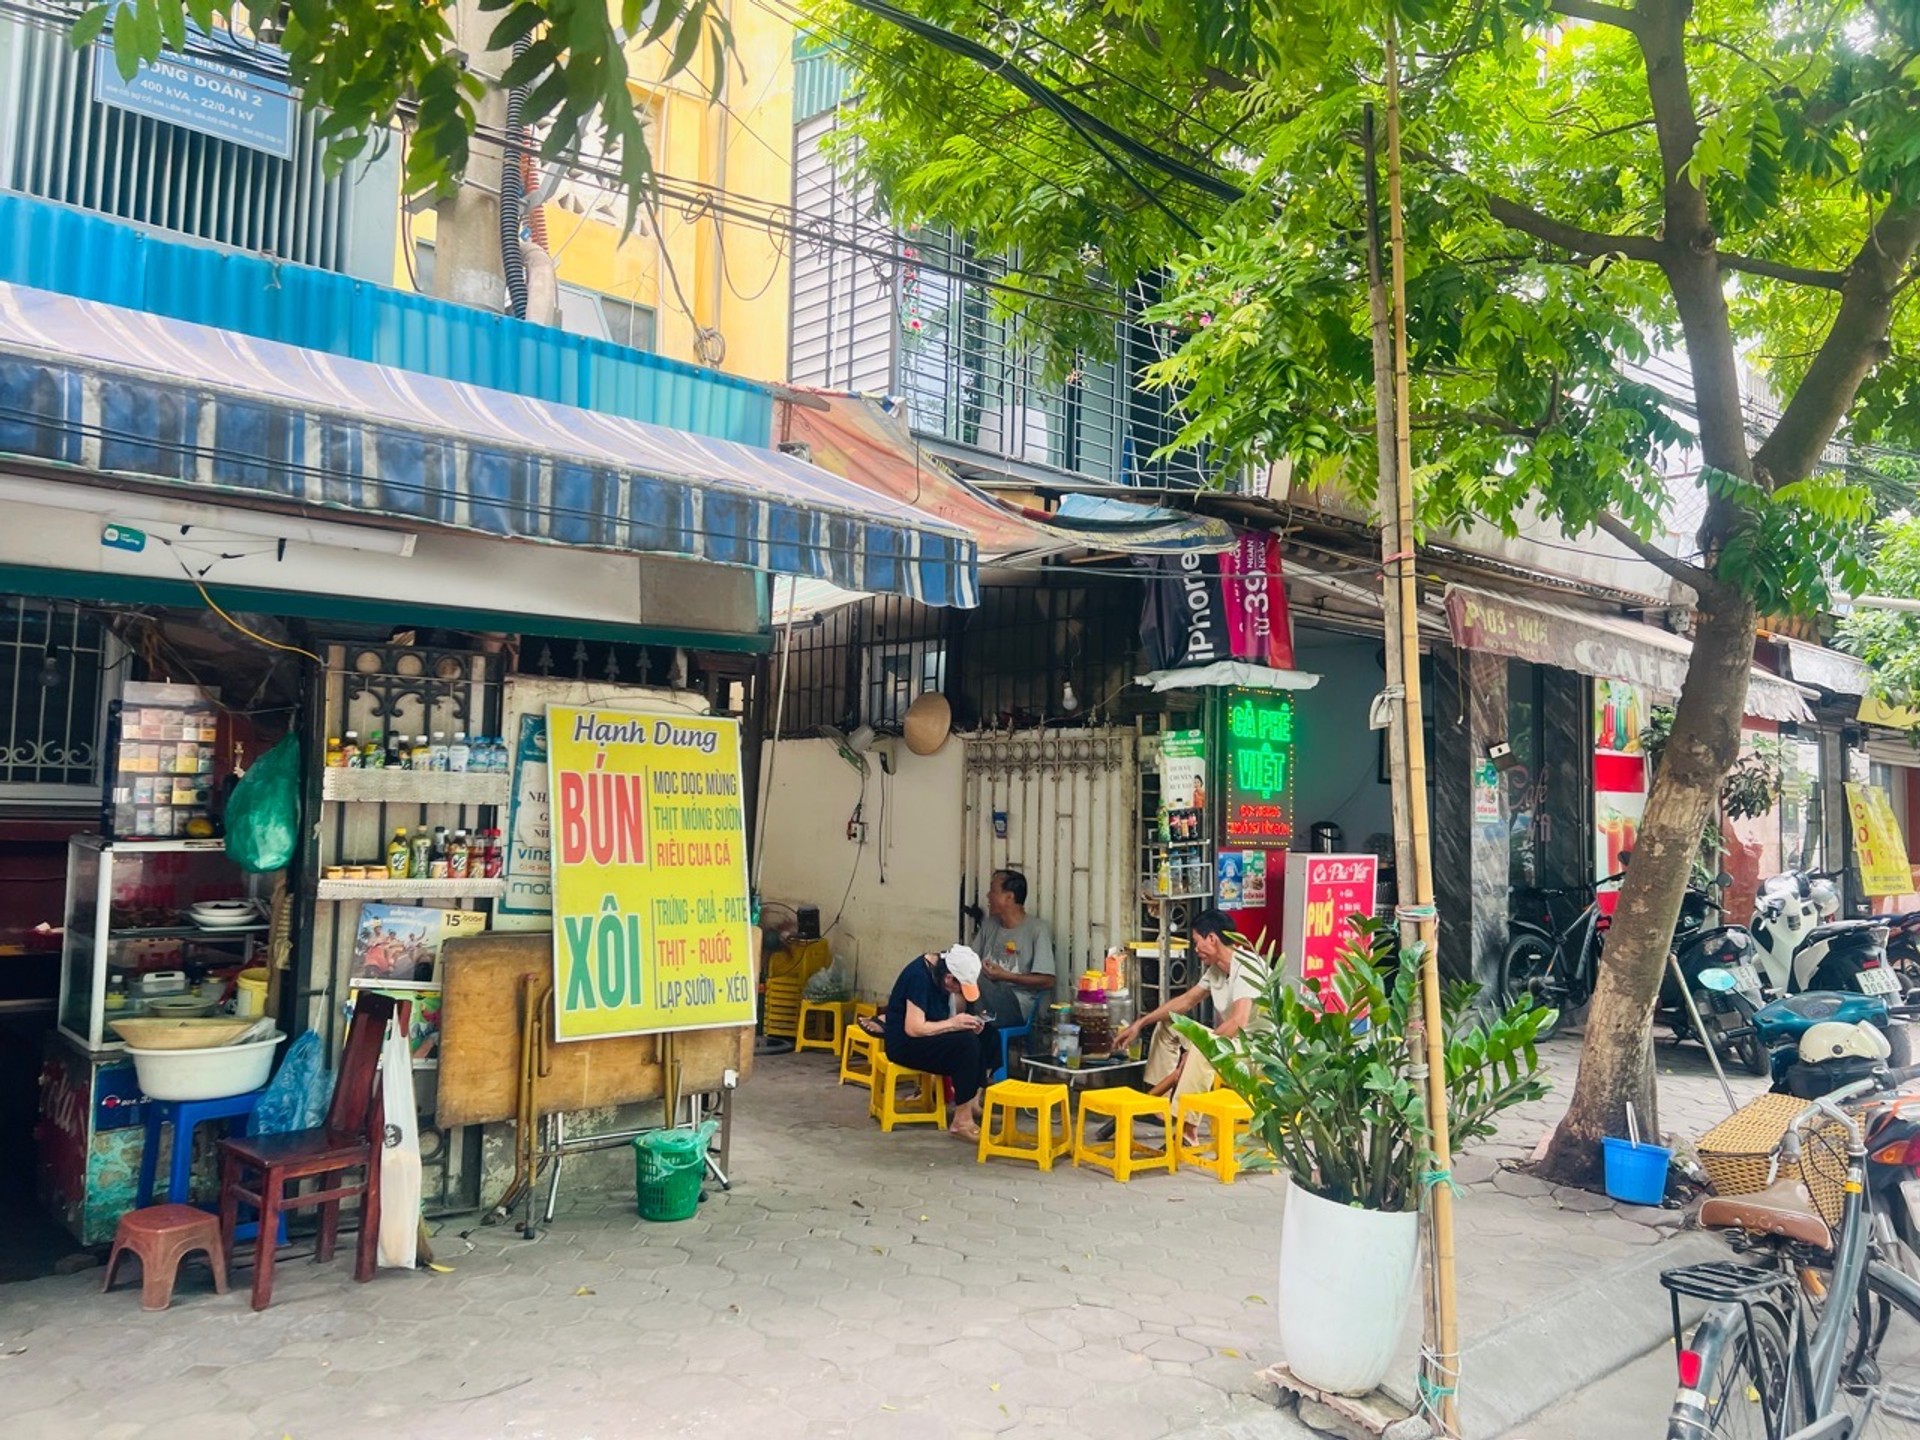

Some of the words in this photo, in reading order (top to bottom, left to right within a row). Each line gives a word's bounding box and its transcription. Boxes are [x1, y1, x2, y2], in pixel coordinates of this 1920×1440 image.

[140, 79, 163, 94] 400
[166, 84, 191, 103] kVA
[238, 109, 255, 122] kV
[194, 76, 248, 102] ĐOÀN
[251, 94, 262, 108] 2
[1181, 552, 1215, 661] iPhone
[1244, 570, 1269, 613] 39
[574, 714, 647, 747] Hạnh
[654, 721, 718, 753] Dung
[1232, 699, 1256, 739] CÀ
[1258, 702, 1292, 743] PHÊ
[653, 770, 679, 799] MỌC
[681, 772, 703, 799] DỌC
[705, 768, 737, 796] MÙNG
[1236, 743, 1285, 801] VIỆT
[528, 791, 549, 802] NH
[561, 753, 645, 866] BÚN
[654, 806, 679, 835] THỊT
[681, 803, 713, 831] MÓNG
[715, 803, 742, 831] SƯỜN
[451, 855, 466, 871] C2
[657, 838, 685, 867] RIÊU
[688, 842, 713, 866] CUA
[715, 838, 731, 866] CÁ
[697, 890, 716, 924] CHẢ
[724, 896, 748, 923] PATE
[1306, 888, 1335, 938] PHỞ
[564, 895, 641, 1011] XÔI
[657, 939, 687, 971] THỊT
[699, 929, 732, 964] RUỐC
[660, 980, 682, 1014] LẠP
[685, 973, 716, 1006] SƯỜN
[726, 971, 748, 1003] XÉO
